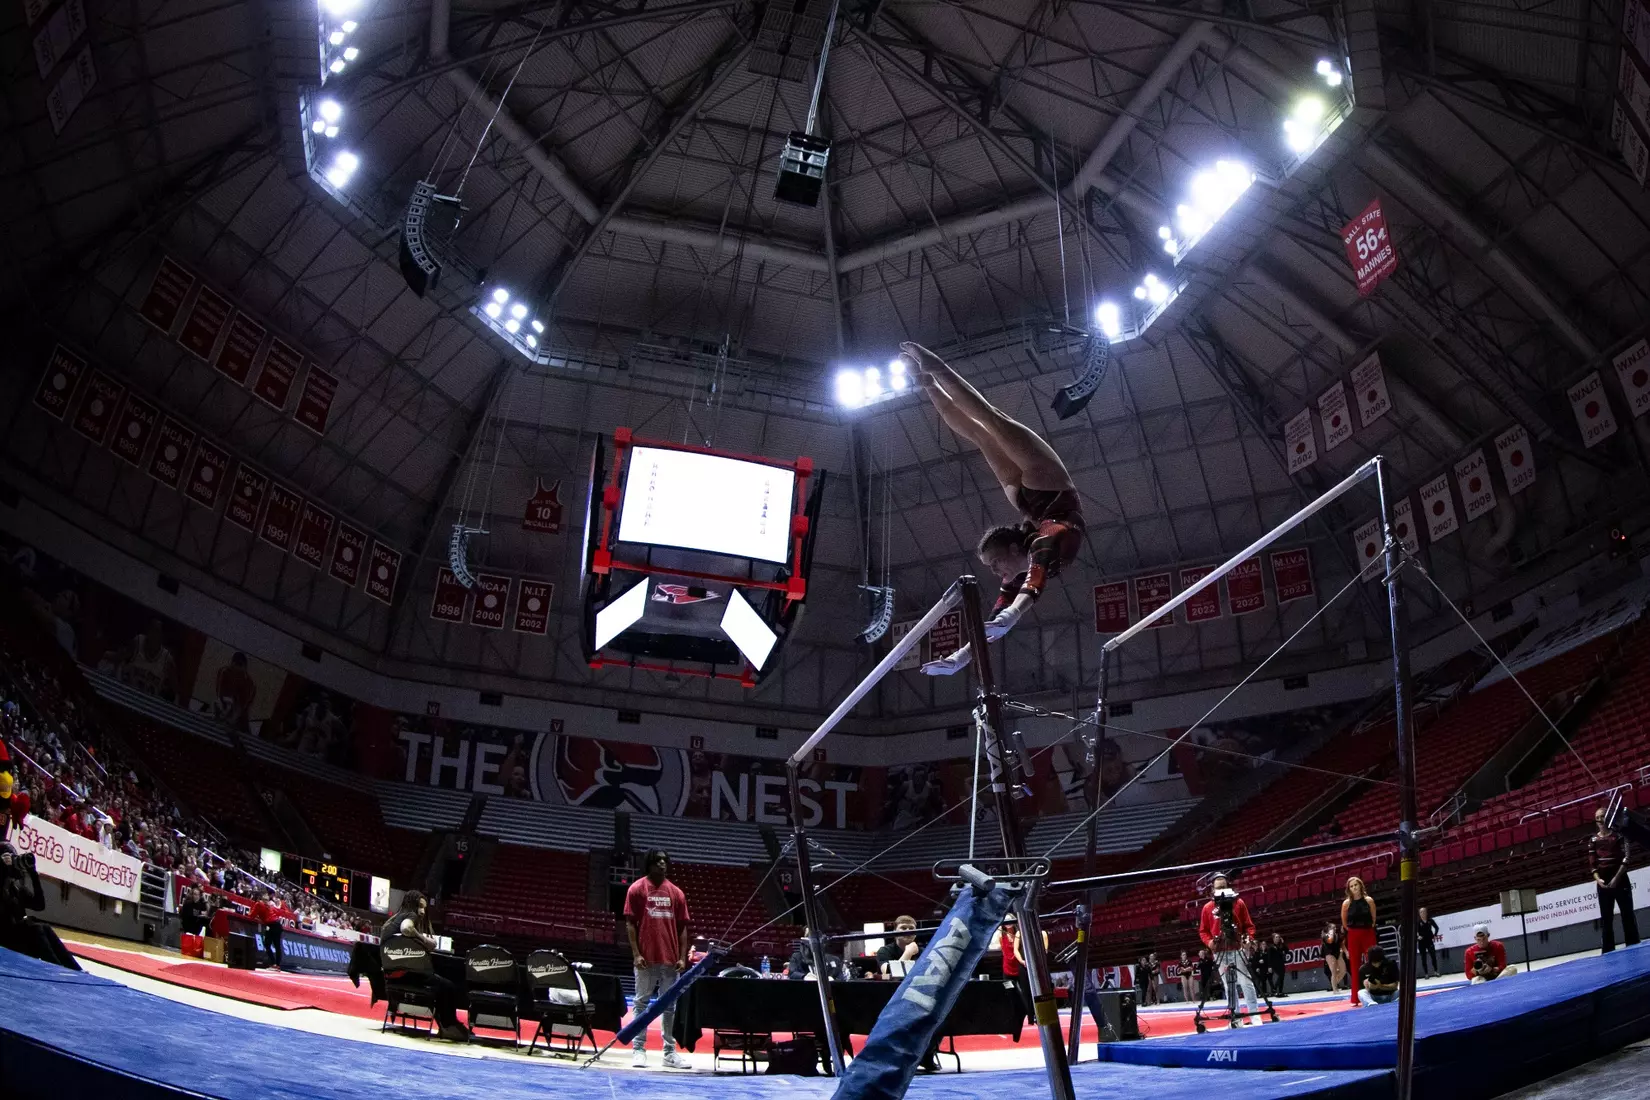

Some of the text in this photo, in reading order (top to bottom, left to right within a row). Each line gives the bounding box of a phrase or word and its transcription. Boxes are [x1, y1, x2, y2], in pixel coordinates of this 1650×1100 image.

[1344, 208, 1381, 245] BALL STATE
[1357, 244, 1392, 280] MANNIES
[126, 402, 154, 426] NCAA
[162, 425, 190, 449] NCAA
[199, 447, 226, 470] NCAA
[1457, 456, 1484, 479] NCAA
[237, 469, 265, 492] NCAA
[536, 507, 551, 520] 10
[267, 524, 289, 543] 1991
[1432, 517, 1453, 535] 2007
[338, 529, 364, 549] NCAA
[300, 541, 322, 562] 1992
[374, 548, 399, 568] NCAA
[479, 580, 507, 593] NCAA
[1183, 572, 1208, 586] NCA
[1283, 584, 1307, 597] 2023
[436, 604, 460, 616] 1998
[1191, 605, 1216, 617] 2022
[1236, 596, 1260, 609] 2022
[475, 610, 501, 621] 2000
[520, 618, 542, 628] 2002
[552, 721, 561, 731] V
[398, 731, 509, 796] THE
[710, 770, 859, 830] NEST
[456, 840, 468, 853] 15
[18, 823, 64, 864] State
[69, 846, 138, 892] University
[321, 863, 337, 876] 2:00
[780, 873, 792, 883] 13
[309, 875, 315, 885] 0
[343, 884, 348, 893] 0
[1555, 896, 1581, 907] SERVICE
[1526, 914, 1550, 924] SERVING
[1551, 908, 1577, 918] INDIANA
[1578, 903, 1597, 912] SINCE
[282, 939, 308, 958] STATE
[309, 944, 351, 964] GYMNASTICS
